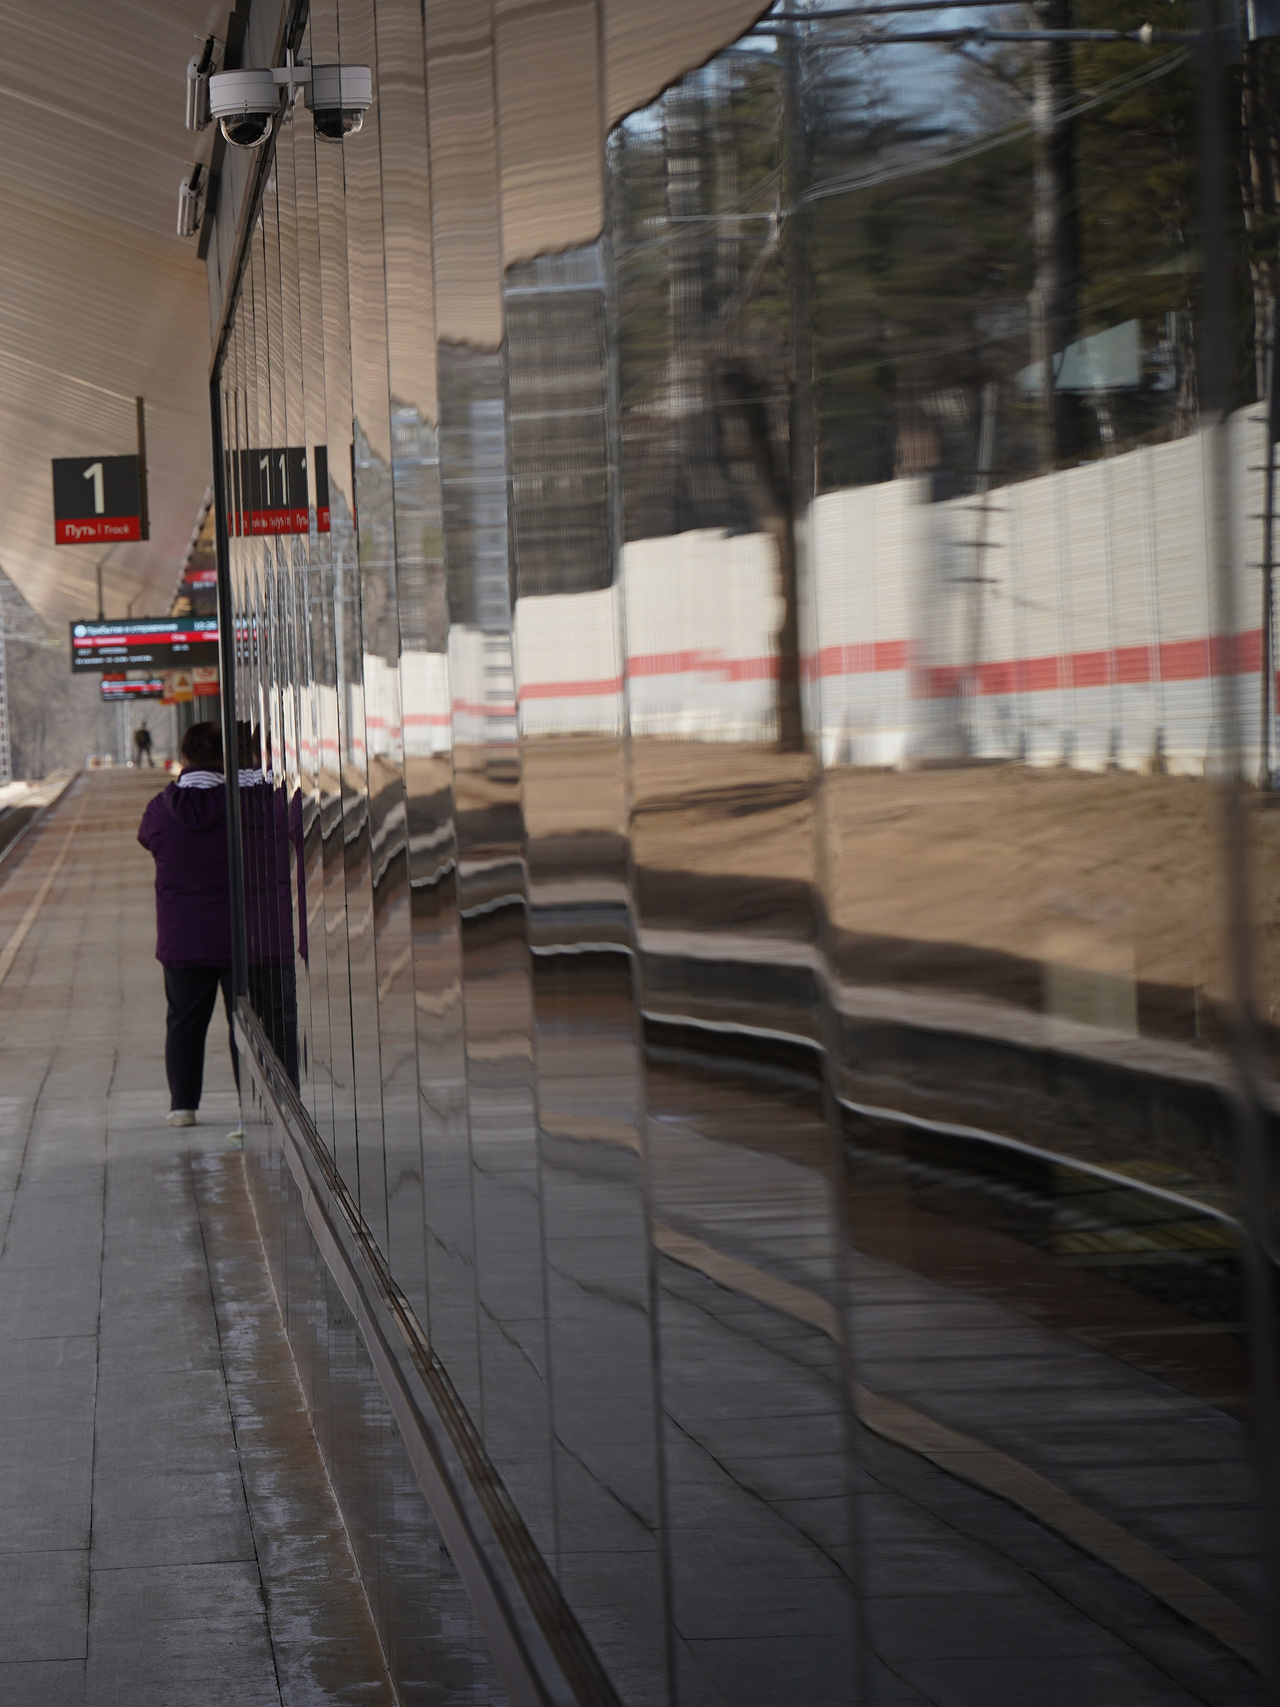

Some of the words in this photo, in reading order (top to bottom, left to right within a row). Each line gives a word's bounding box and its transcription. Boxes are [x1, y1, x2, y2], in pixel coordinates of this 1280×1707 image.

[82, 462, 105, 515] 1
[65, 523, 96, 539] Путь
[103, 523, 131, 535] Track
